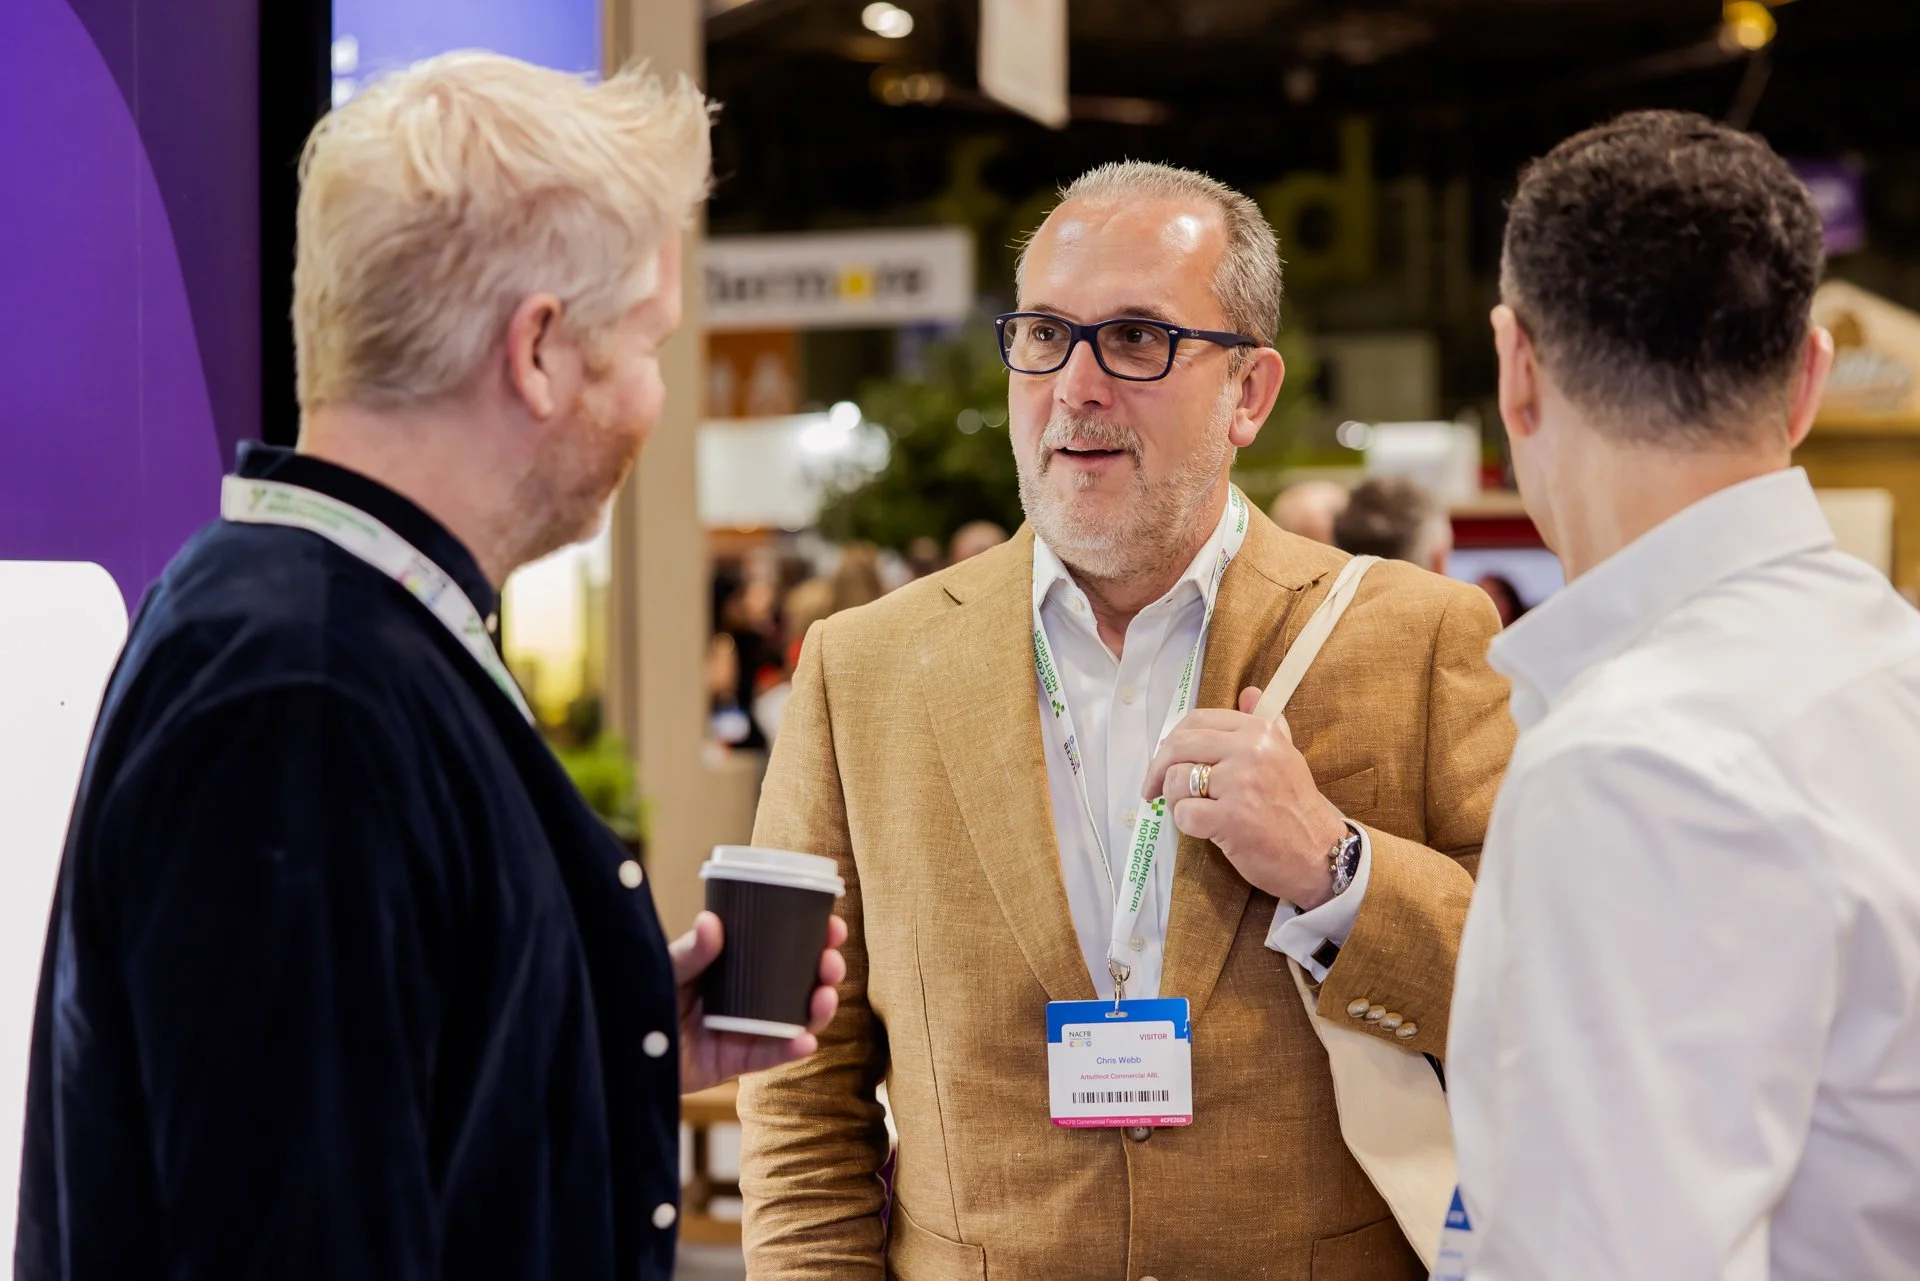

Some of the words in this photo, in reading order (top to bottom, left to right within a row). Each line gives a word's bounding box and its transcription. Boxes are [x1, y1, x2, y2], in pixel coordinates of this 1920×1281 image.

[1034, 630, 1059, 692] MORTGAGES
[1043, 676, 1054, 697] YBS
[1150, 820, 1161, 841] YBS
[1129, 818, 1151, 883] MORTGAGES
[1129, 843, 1155, 913] COMMERCIAL
[1068, 1030, 1092, 1038] NACFB
[1139, 1033, 1168, 1041] VISITOR
[1096, 1056, 1117, 1065] Chris
[1118, 1056, 1142, 1064] Webb
[1110, 1072, 1146, 1080] Commercial
[1126, 1117, 1139, 1125] Expo
